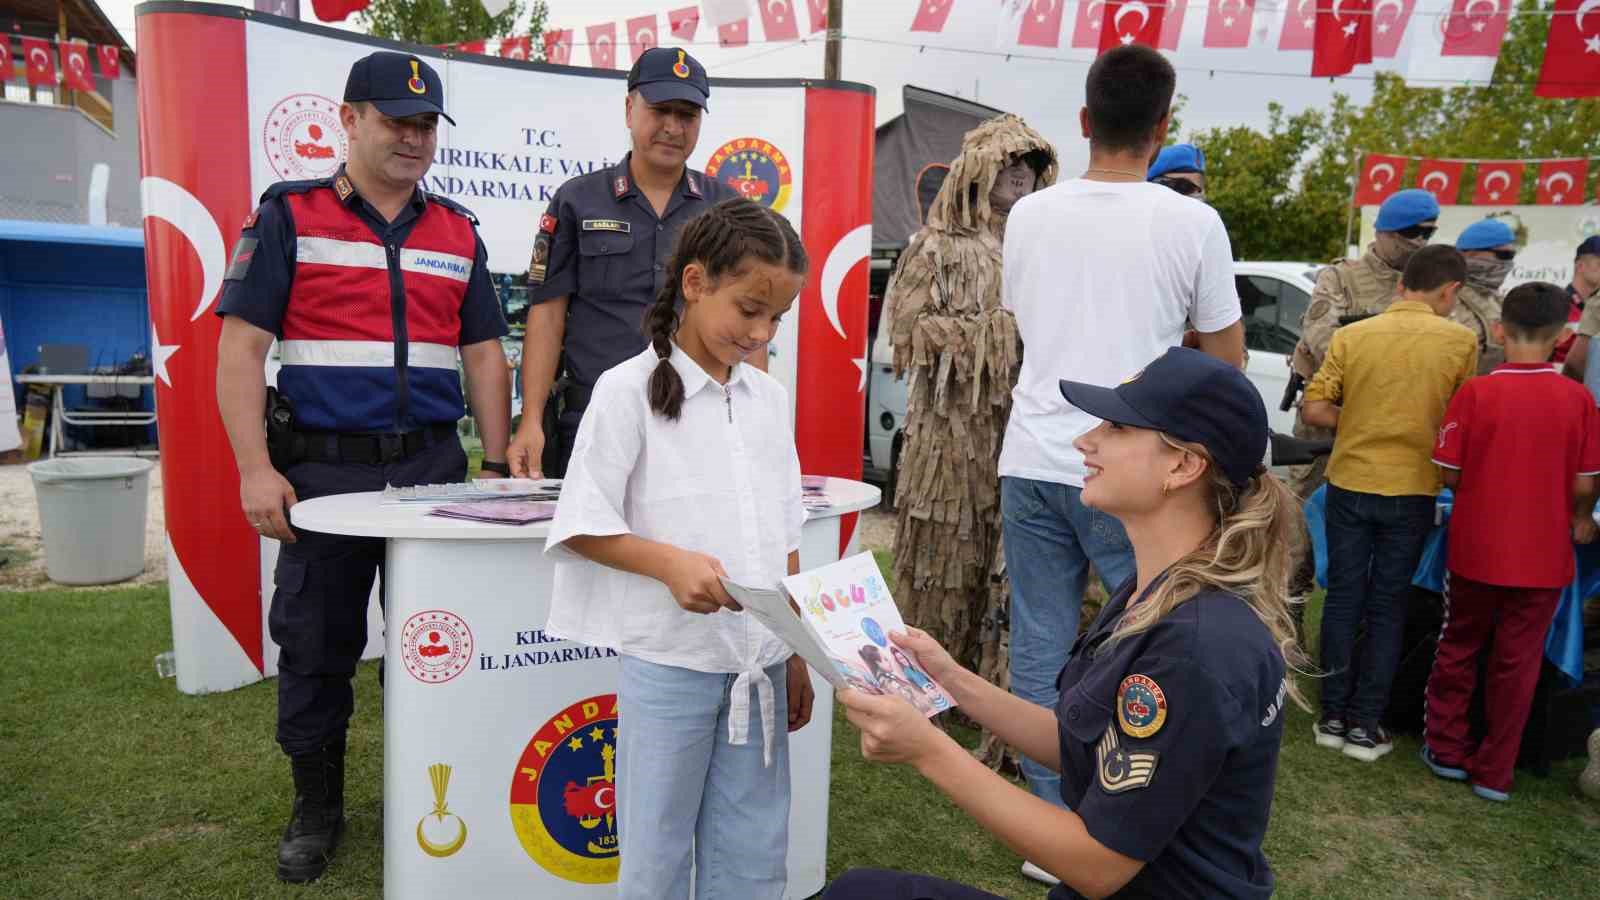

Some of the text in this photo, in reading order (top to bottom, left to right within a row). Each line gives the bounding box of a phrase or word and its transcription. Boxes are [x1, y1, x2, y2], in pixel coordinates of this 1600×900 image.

[522, 128, 561, 148] T.C.
[432, 148, 553, 175] IRIKKALE
[708, 139, 789, 175] JANDARMA
[421, 175, 533, 201] ANDARMA
[414, 257, 466, 273] JANDARMA
[480, 652, 499, 670] İL
[502, 646, 602, 669] JANDARMA
[599, 833, 621, 846] 183
